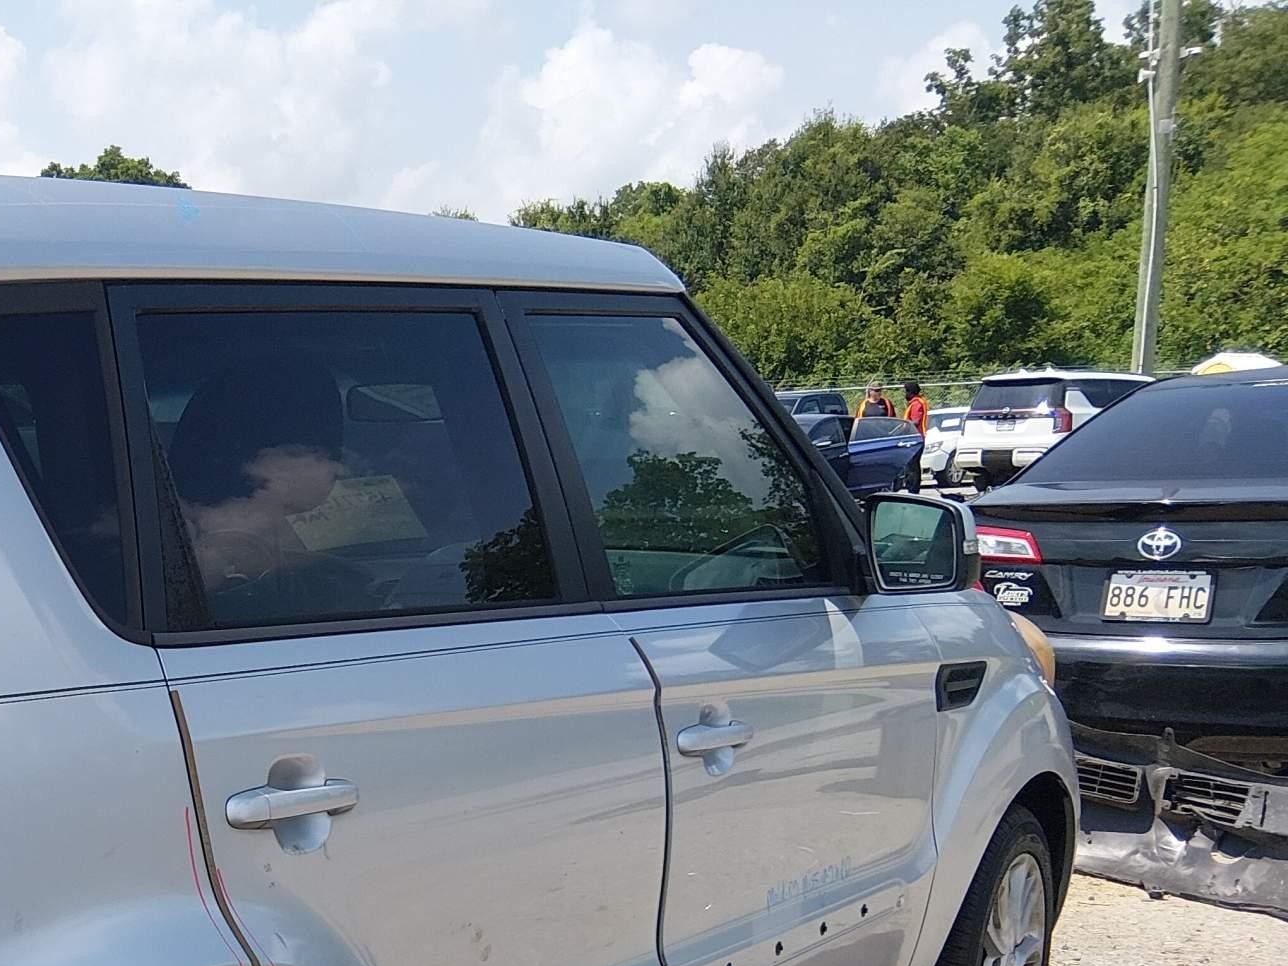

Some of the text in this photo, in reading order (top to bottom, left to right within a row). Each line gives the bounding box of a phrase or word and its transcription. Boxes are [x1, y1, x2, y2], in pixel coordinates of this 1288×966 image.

[984, 569, 1035, 581] CAMRY
[1109, 586, 1207, 610] 886 FHC
